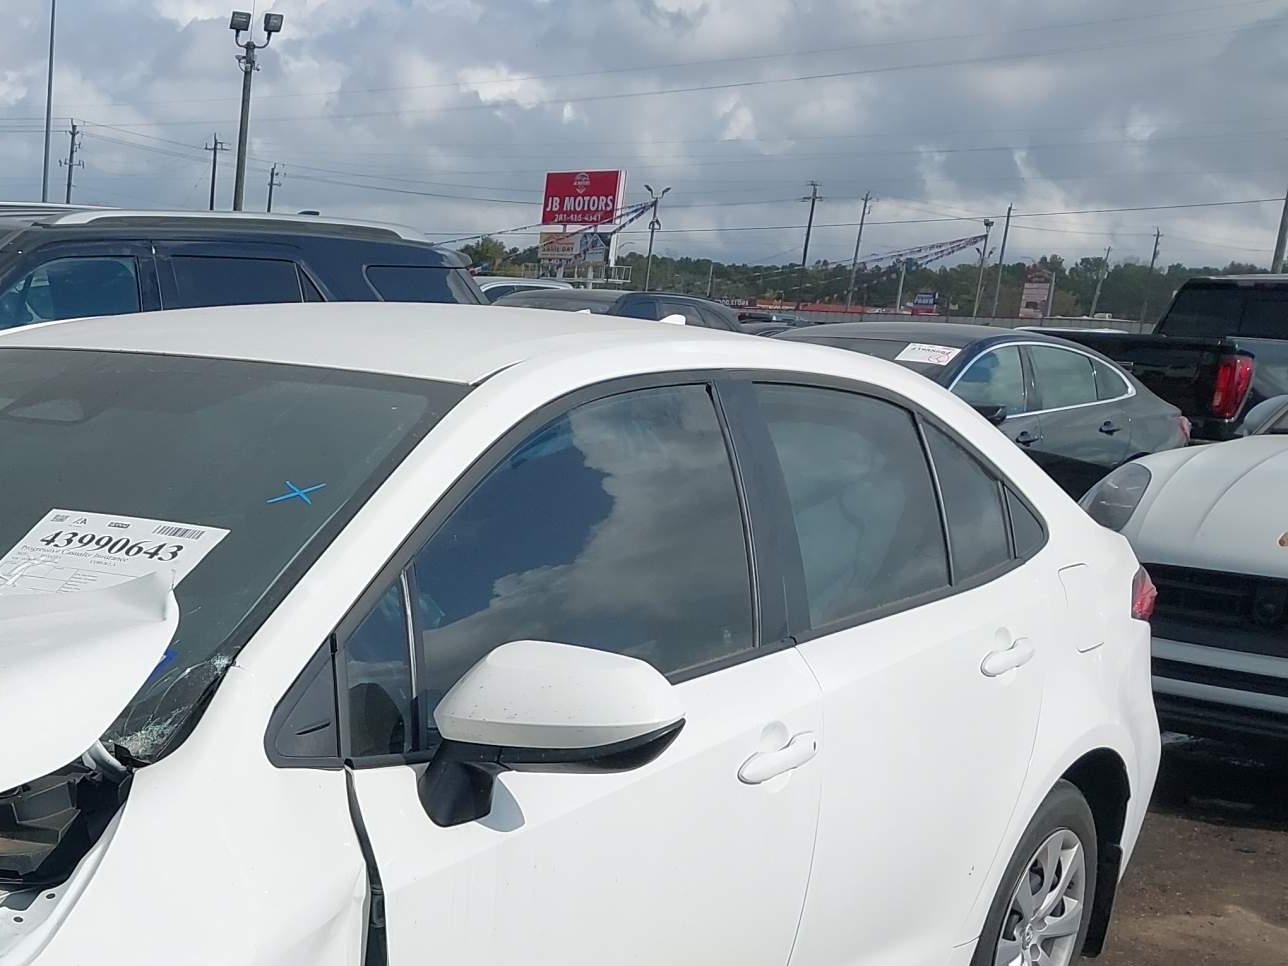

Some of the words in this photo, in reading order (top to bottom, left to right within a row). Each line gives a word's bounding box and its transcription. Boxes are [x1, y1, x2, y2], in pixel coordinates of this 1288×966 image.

[546, 196, 560, 211] JB
[563, 195, 614, 211] MOTORS
[40, 530, 184, 562] 43990643
